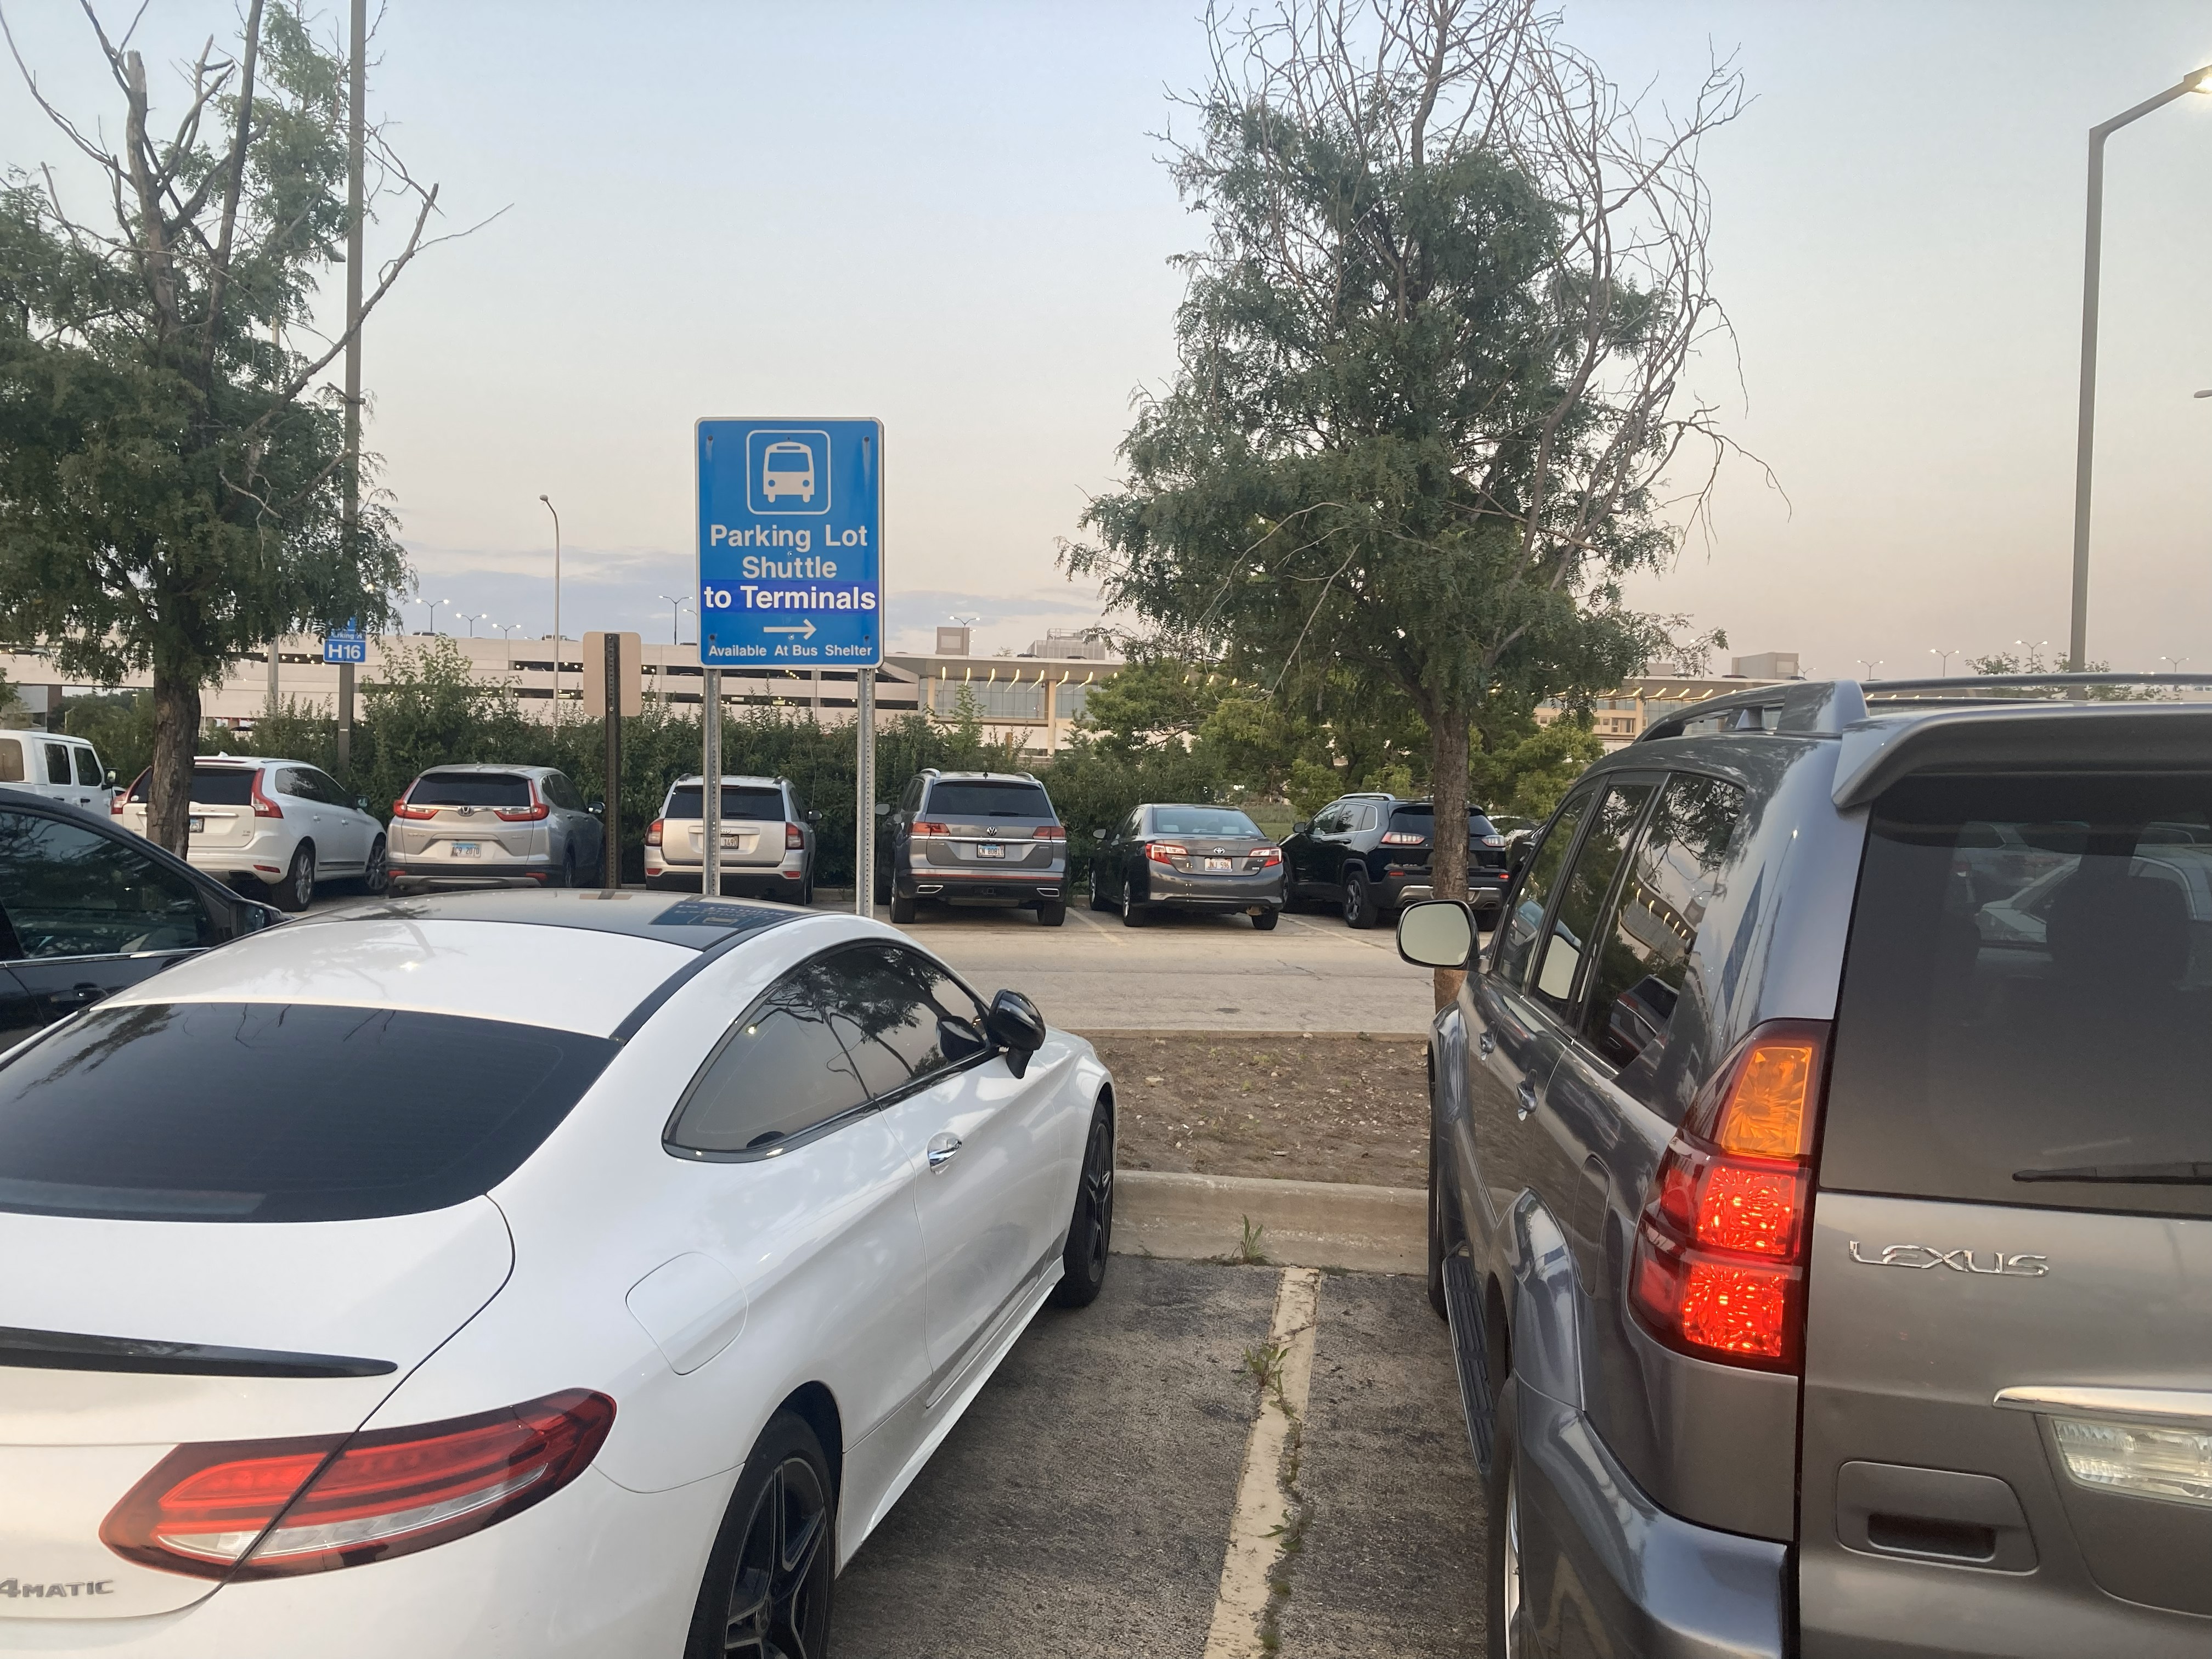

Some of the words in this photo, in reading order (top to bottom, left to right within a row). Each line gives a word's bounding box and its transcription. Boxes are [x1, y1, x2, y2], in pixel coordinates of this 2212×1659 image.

[710, 524, 811, 553] Parking
[826, 524, 868, 547] Lot
[742, 556, 837, 579] Shuttle
[704, 586, 732, 609] to
[740, 585, 876, 610] Terminals
[328, 644, 361, 659] H16
[708, 645, 767, 656] Available
[774, 645, 788, 656] At
[792, 645, 818, 657] Bus
[825, 645, 872, 657] Shelter
[724, 838, 737, 847] 1490
[1848, 1240, 2050, 1277] LEXUS
[0, 1578, 114, 1598] 4MATIC
